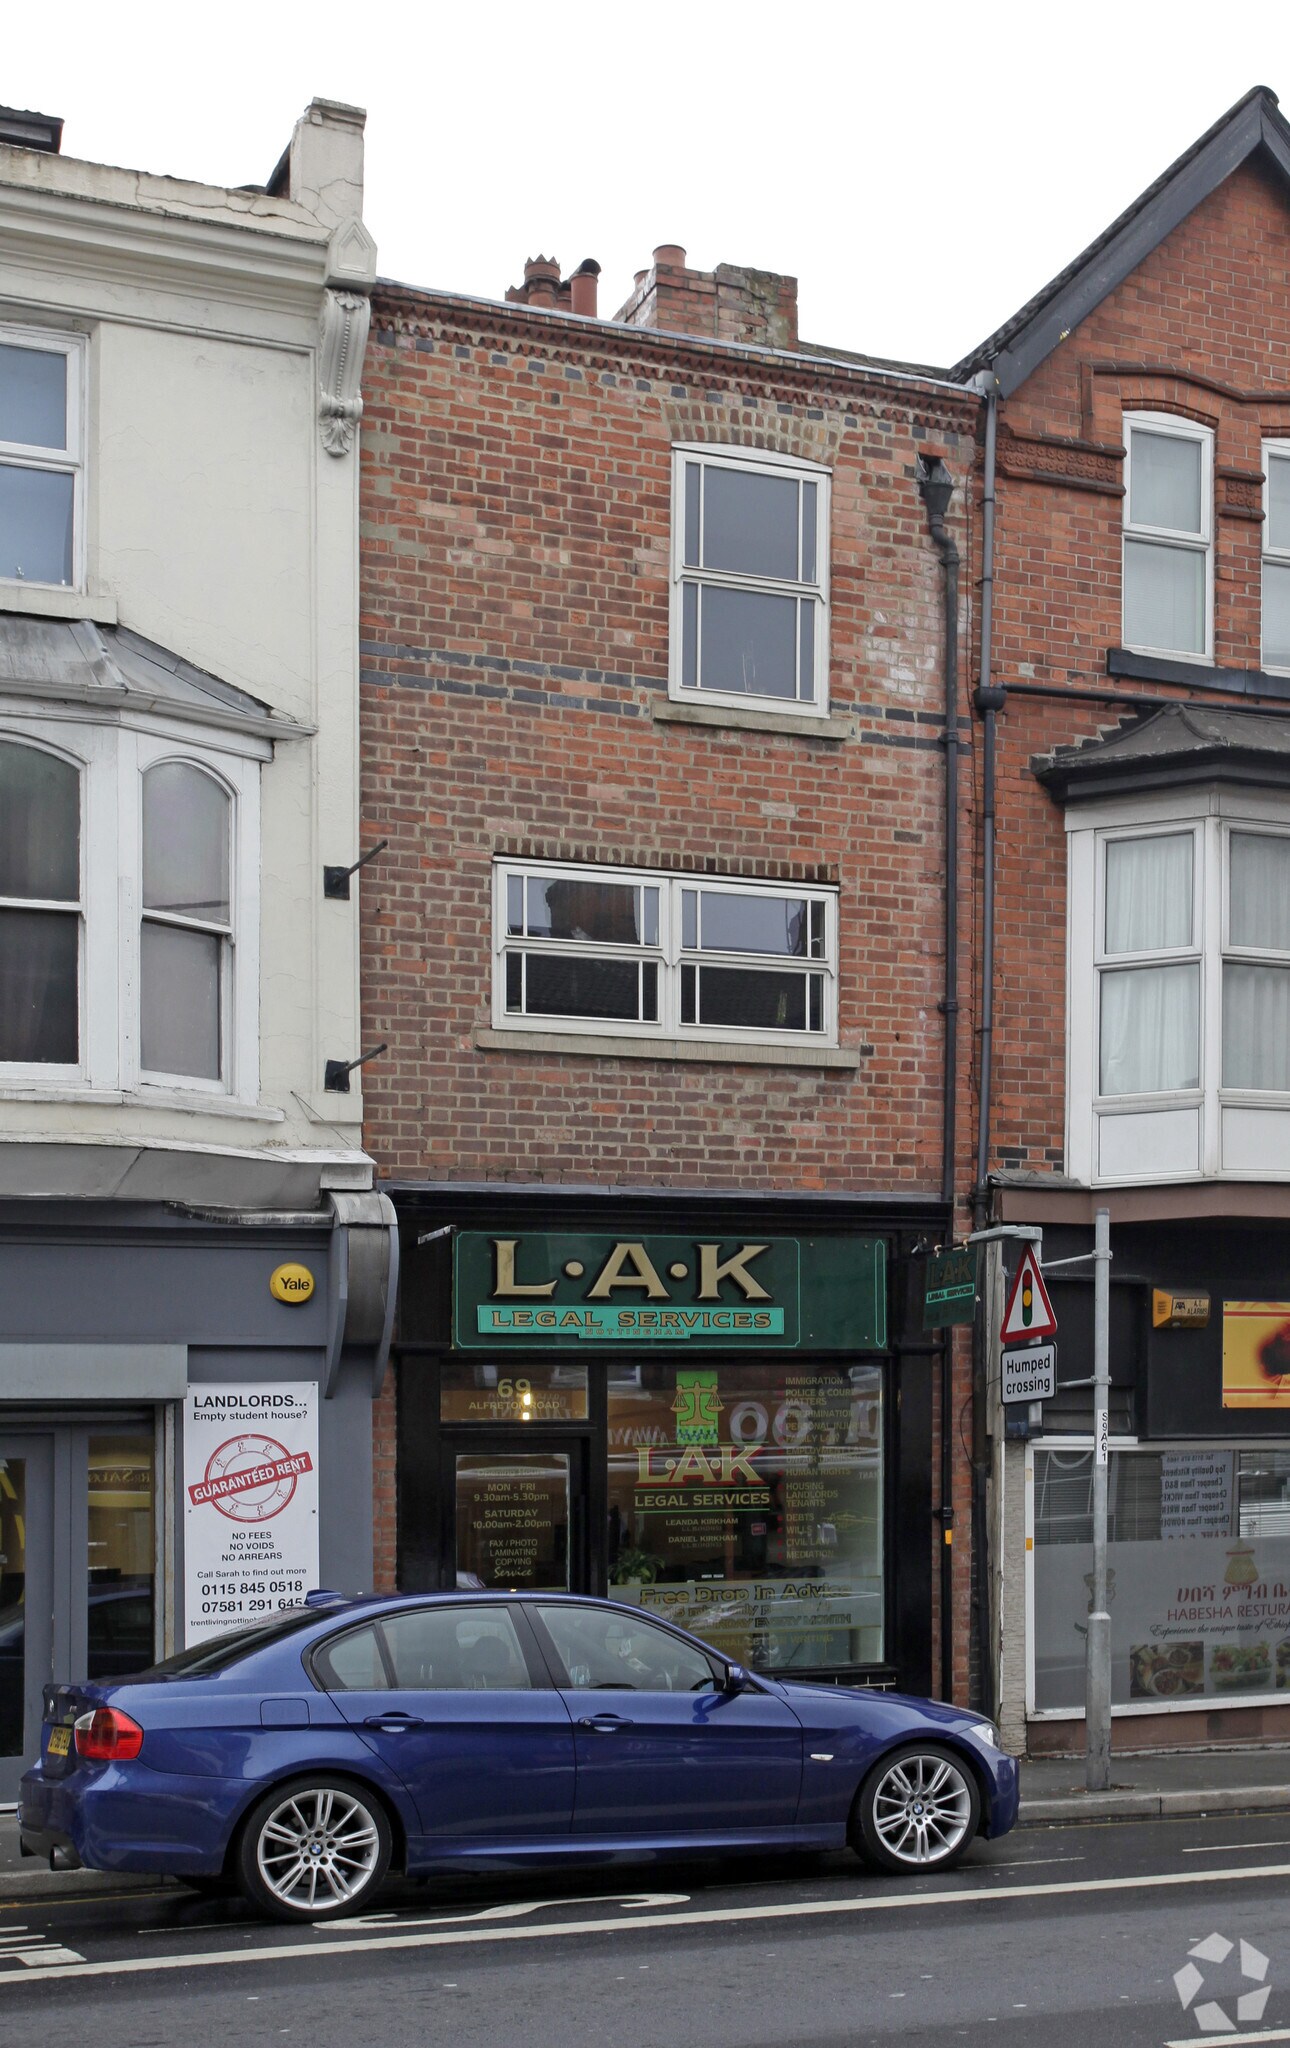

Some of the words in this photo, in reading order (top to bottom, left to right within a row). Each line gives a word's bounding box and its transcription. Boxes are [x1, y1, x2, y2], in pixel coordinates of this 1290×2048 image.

[280, 1277, 310, 1291] Yale
[491, 1310, 603, 1328] LEGAL
[617, 1311, 772, 1329] SERVICES
[584, 1328, 686, 1336] NOTTINGHAM
[1006, 1354, 1051, 1375] Humped
[785, 1376, 844, 1386] IMMIGRATION
[1006, 1377, 1051, 1395] crossing
[497, 1378, 531, 1399] 69
[785, 1388, 817, 1397] POLICE
[818, 1388, 825, 1397] &
[193, 1394, 308, 1408] LANDLORDS...
[468, 1400, 525, 1410] ALFRETON
[529, 1400, 560, 1410] ROAD
[785, 1397, 828, 1406] MATTERS
[193, 1411, 226, 1422] Empty
[229, 1410, 269, 1421] student
[270, 1410, 308, 1420] house?
[785, 1467, 818, 1477] HUMAN
[820, 1467, 852, 1476] RIGHTS
[193, 1466, 275, 1501] GUARANTEED
[276, 1455, 307, 1476] RENT
[487, 1483, 511, 1492] MON
[519, 1483, 536, 1491] FRI
[785, 1481, 825, 1490] HOUSING
[785, 1489, 839, 1499] LANDLORDS
[634, 1494, 688, 1508] LEGAL
[692, 1492, 770, 1506] SERVICES
[786, 1498, 827, 1507] TENANTS
[484, 1509, 539, 1519] SATURDAY
[786, 1512, 815, 1521] DEBTS
[665, 1517, 699, 1527] LEANDA
[701, 1517, 739, 1526] KIRKHAM
[786, 1525, 813, 1534] WILLS
[231, 1532, 246, 1540] NO
[248, 1531, 272, 1540] FEES
[667, 1535, 699, 1544] DANIEL
[700, 1534, 738, 1543] KIRKHAM
[229, 1542, 244, 1550] NO
[246, 1541, 275, 1550] VOIDS
[489, 1539, 503, 1548] FAX
[510, 1538, 538, 1547] PHOTO
[786, 1537, 808, 1547] CIVIL
[221, 1553, 236, 1562] NO
[238, 1552, 283, 1561] ARREARS
[489, 1547, 538, 1557] LAMINATING
[785, 1550, 835, 1560] MEDIATION
[494, 1557, 532, 1566] COPYING
[197, 1570, 213, 1579] Call
[215, 1569, 240, 1578] Sarah
[252, 1567, 268, 1576] find
[270, 1567, 284, 1576] out
[286, 1567, 307, 1575] more
[493, 1565, 534, 1579] Service
[201, 1582, 236, 1596] 0115
[240, 1581, 266, 1595] 845
[269, 1579, 303, 1593] 0518
[639, 1587, 690, 1605] Free
[694, 1585, 750, 1604] Drop
[754, 1584, 776, 1601] In
[782, 1582, 853, 1600] Advice
[201, 1599, 243, 1614] 07581
[248, 1598, 272, 1612] 291
[1167, 1605, 1234, 1621] HABESHA
[1149, 1623, 1197, 1640] Experience
[1198, 1623, 1209, 1634] the
